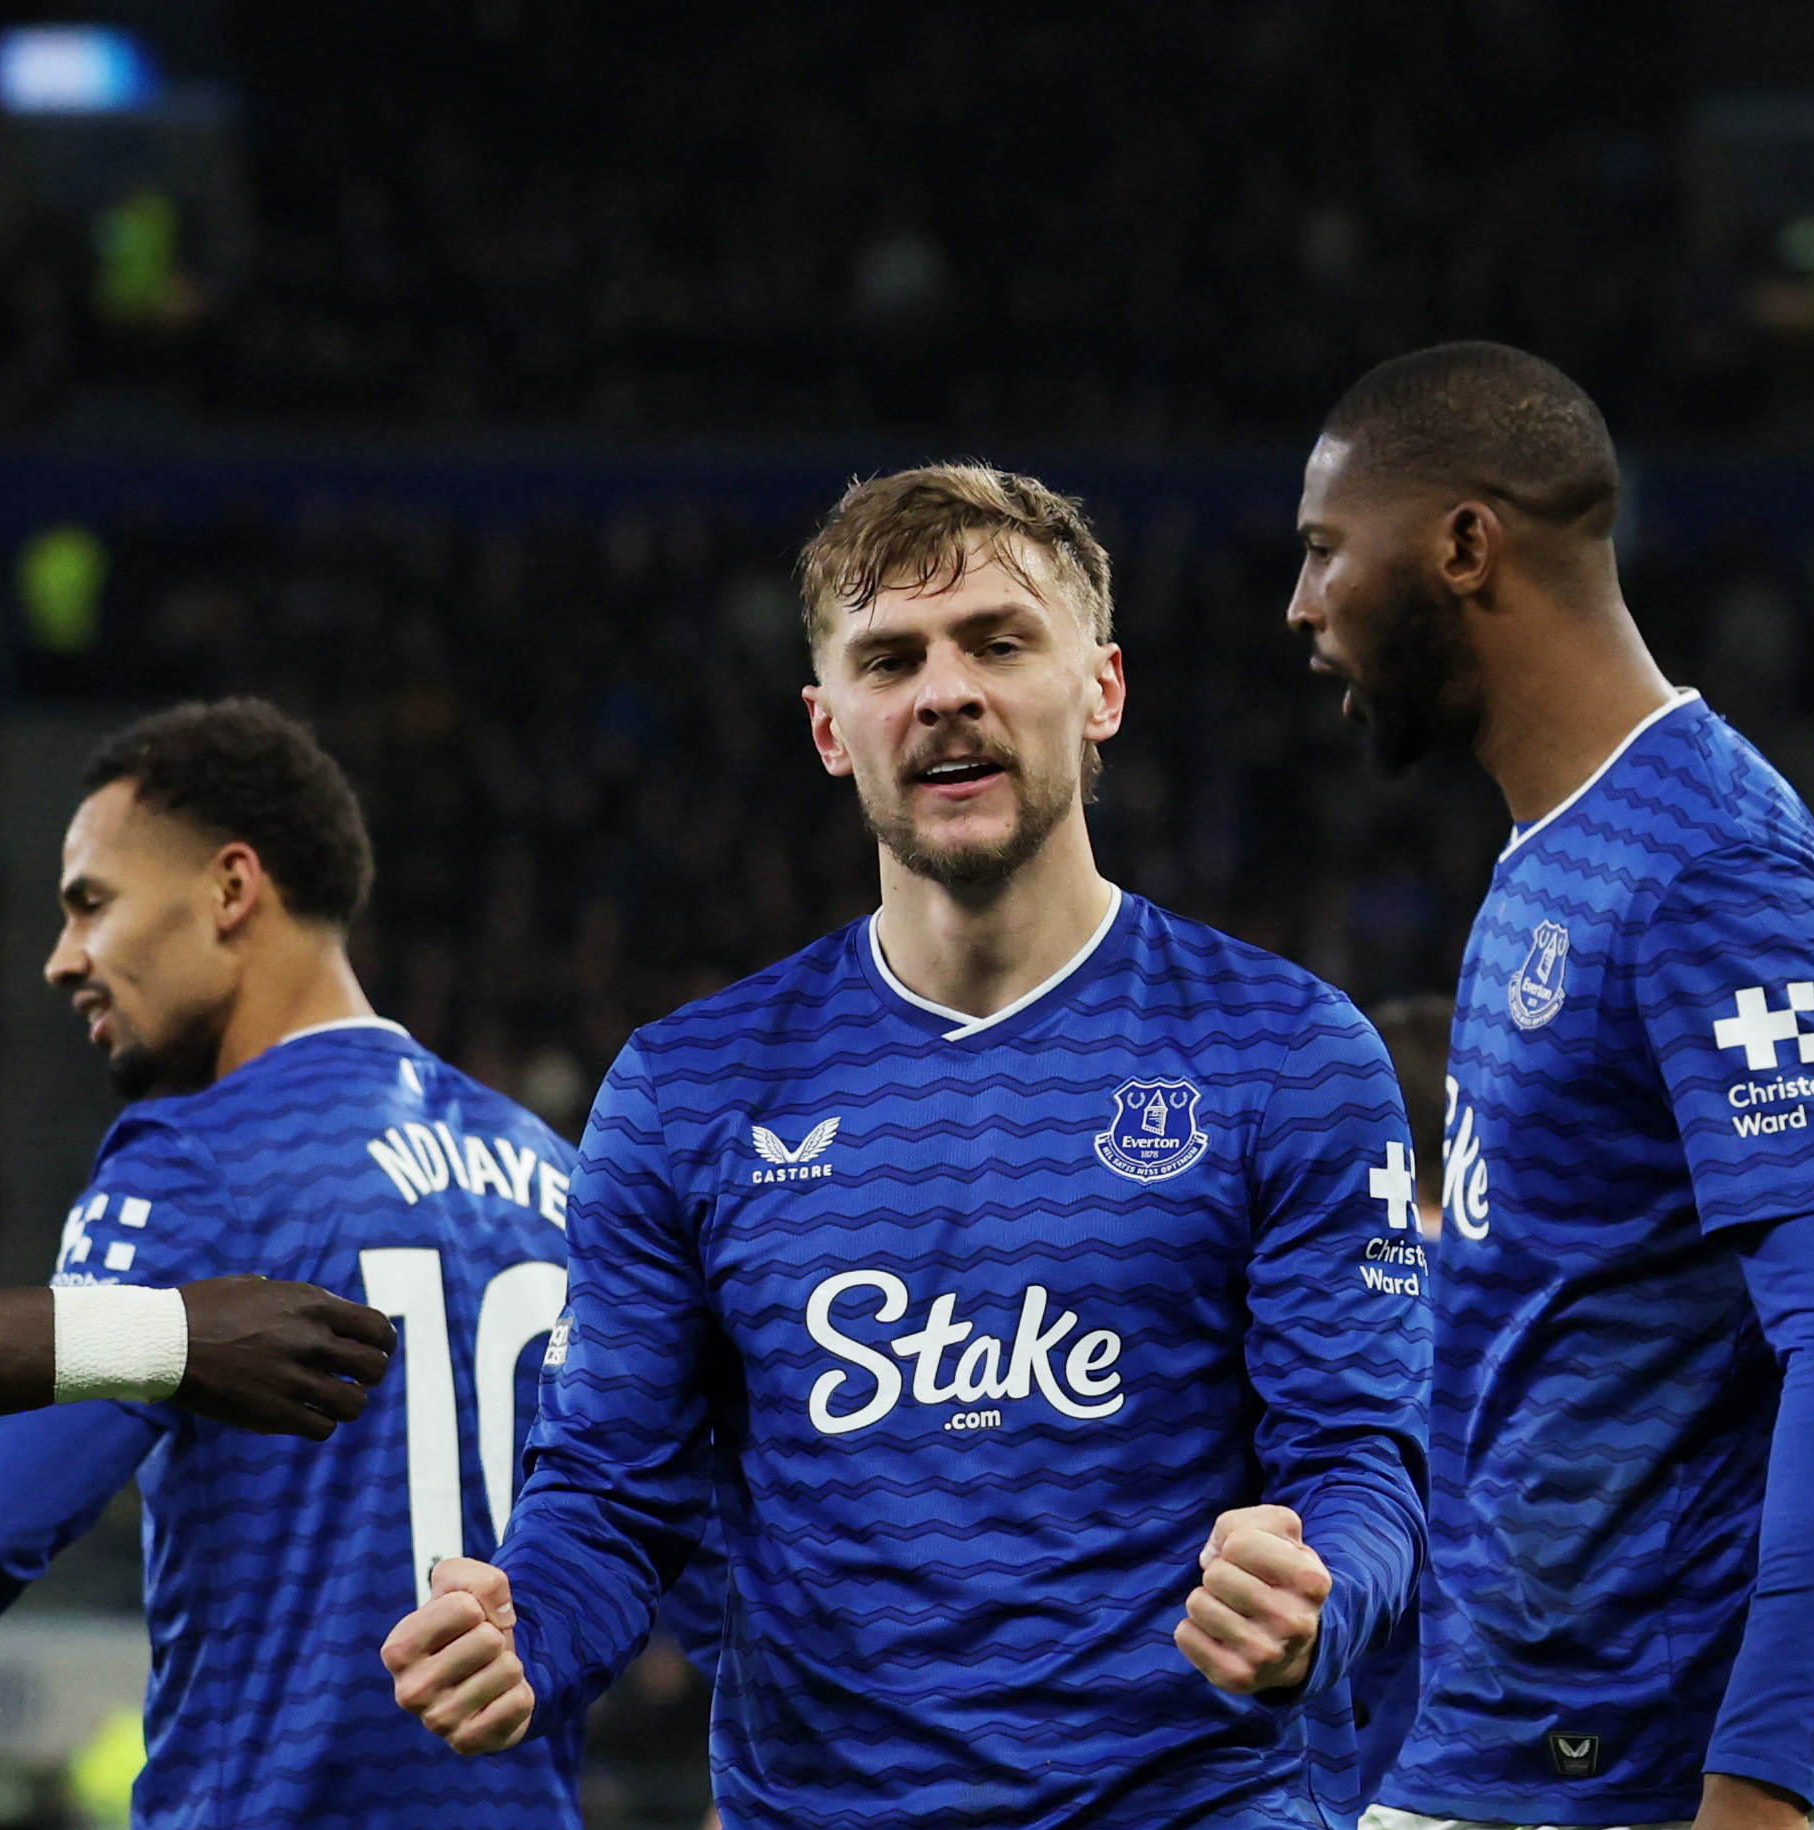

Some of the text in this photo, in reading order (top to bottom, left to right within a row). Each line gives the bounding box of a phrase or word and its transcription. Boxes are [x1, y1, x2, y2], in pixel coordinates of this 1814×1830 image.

[1732, 1104, 1808, 1138] Ward
[1121, 1135, 1180, 1149] Everton
[366, 1119, 570, 1232] NDIAYE
[751, 1164, 833, 1184] CASTORE
[1359, 1265, 1420, 1297] Ward
[806, 1269, 1124, 1434] Stake
[944, 1409, 1001, 1431] .com
